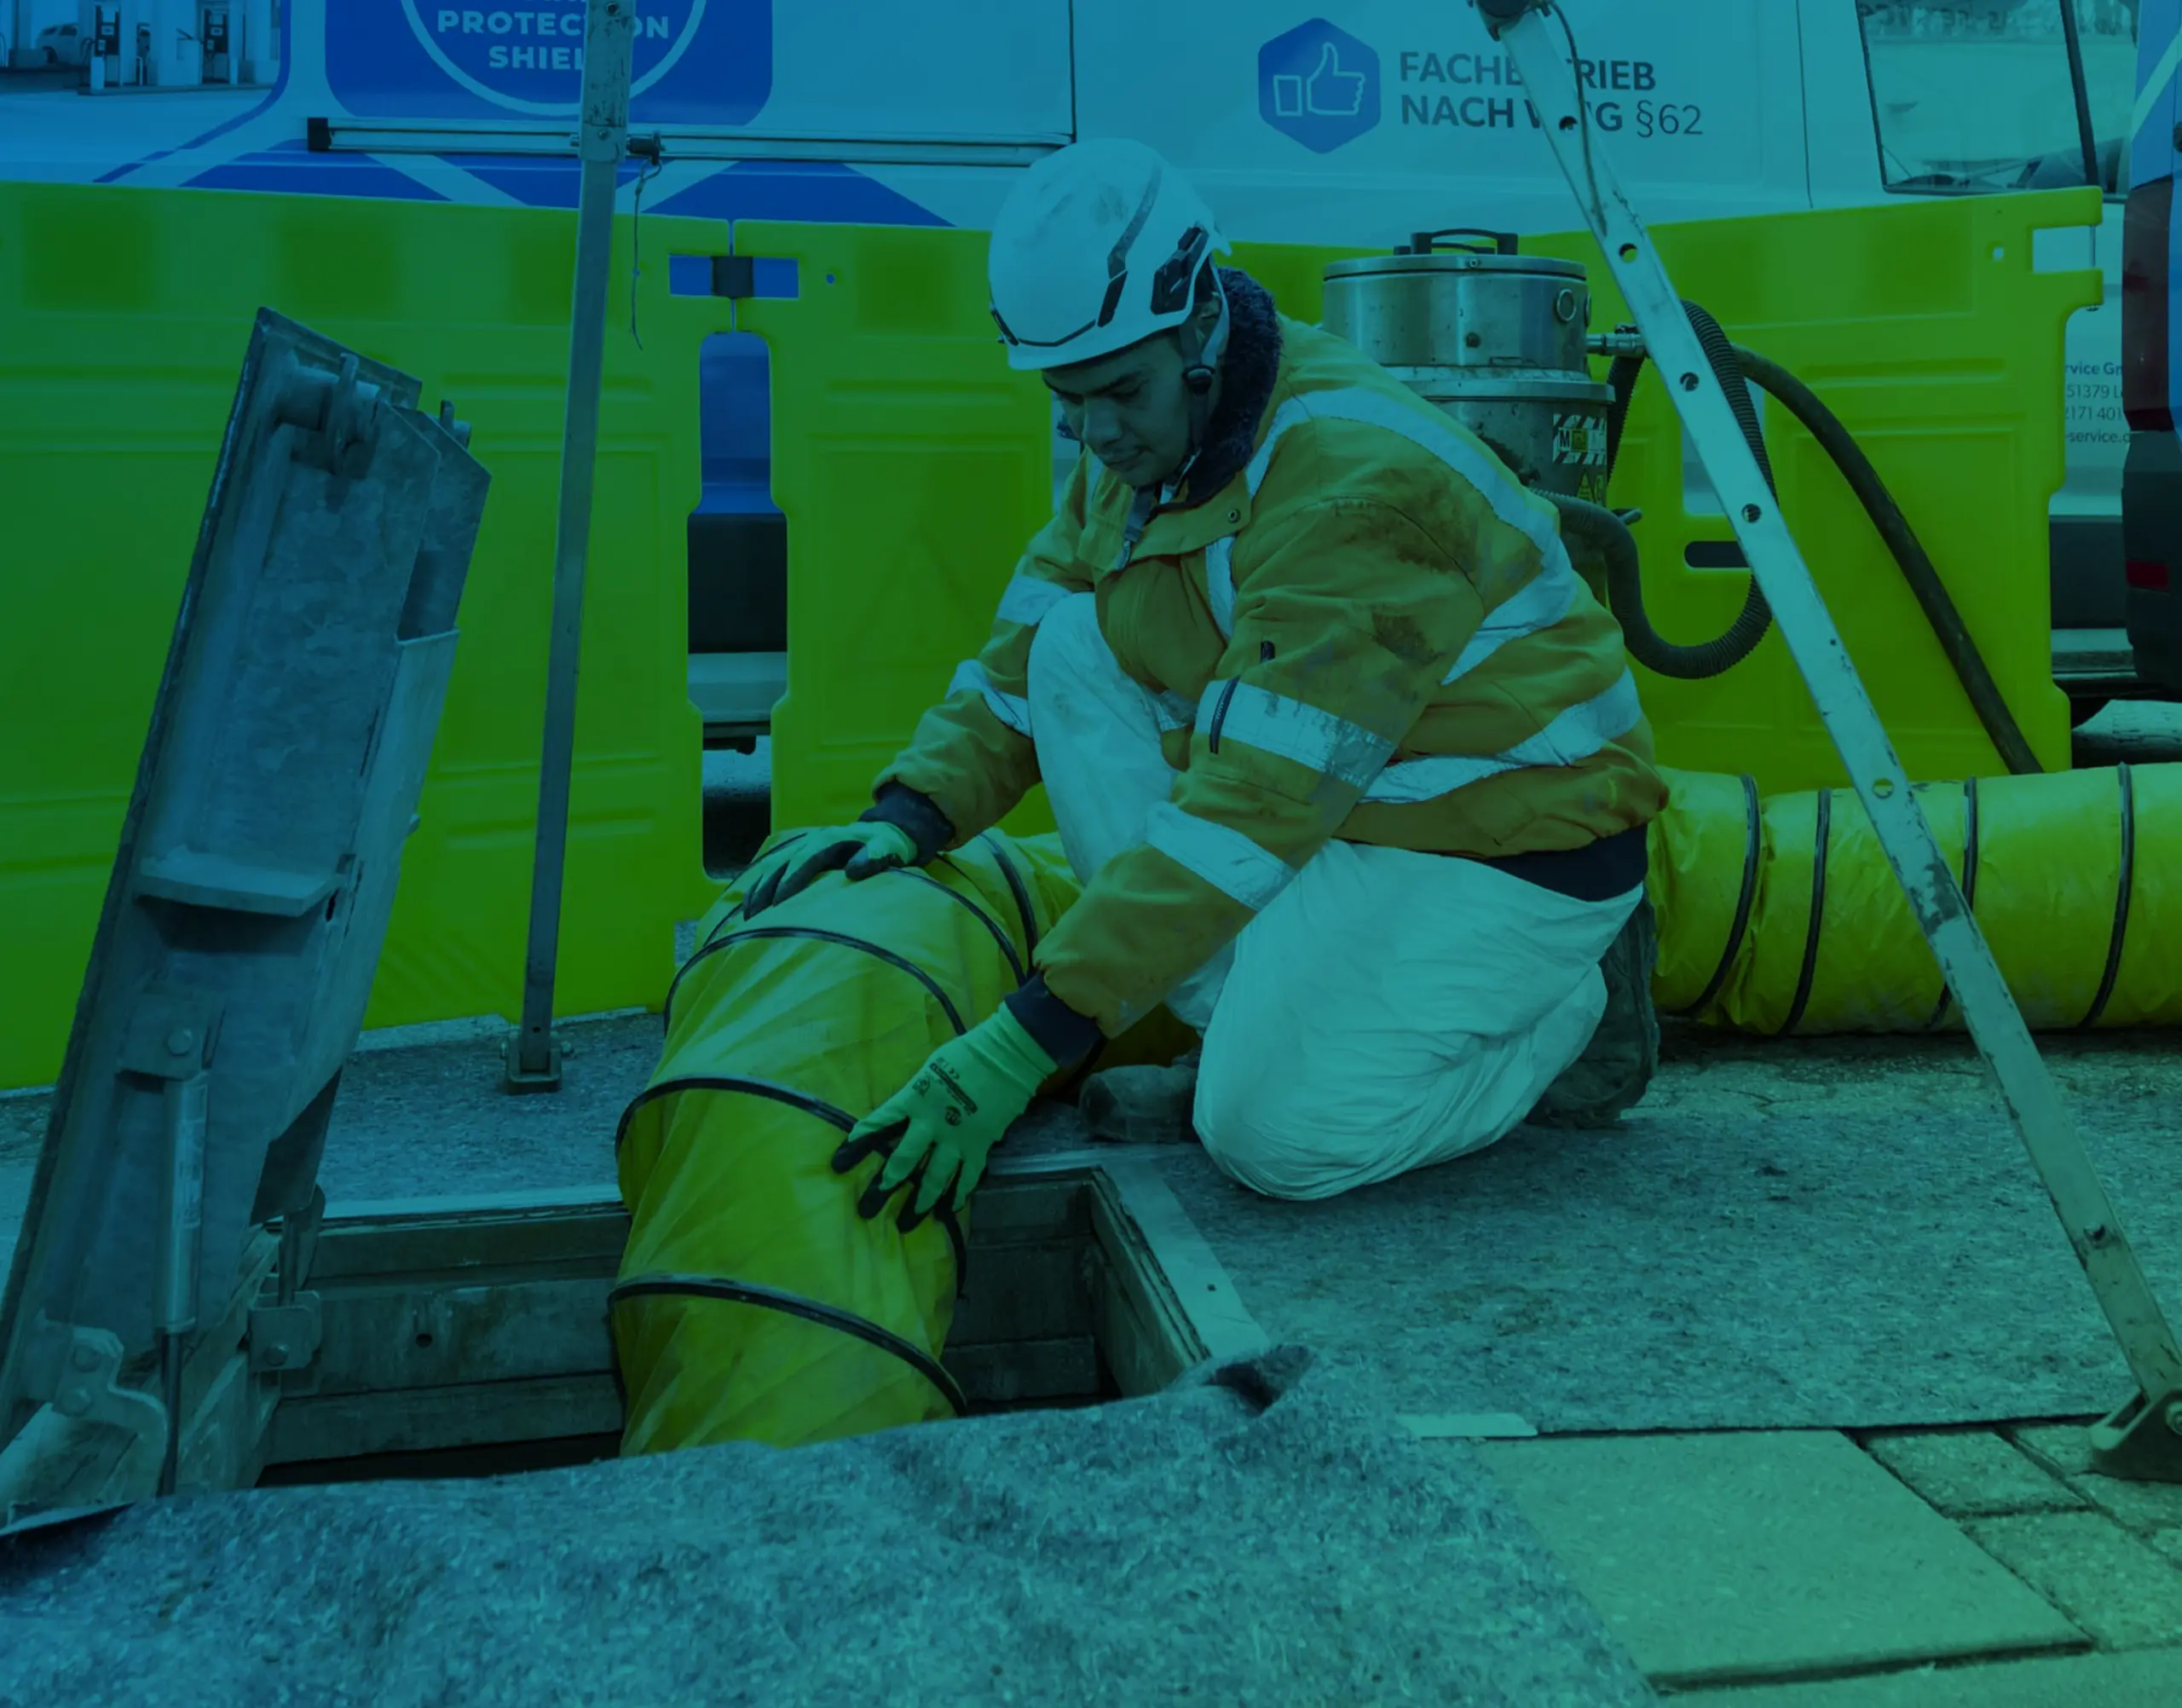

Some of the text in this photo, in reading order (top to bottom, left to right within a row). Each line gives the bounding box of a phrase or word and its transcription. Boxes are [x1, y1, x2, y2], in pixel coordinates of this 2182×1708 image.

[437, 9, 668, 38] PROTECN
[488, 46, 584, 70] SHIEL
[1401, 94, 1514, 129] NACH
[1636, 99, 1703, 138] §62
[2066, 384, 2110, 399] 51379
